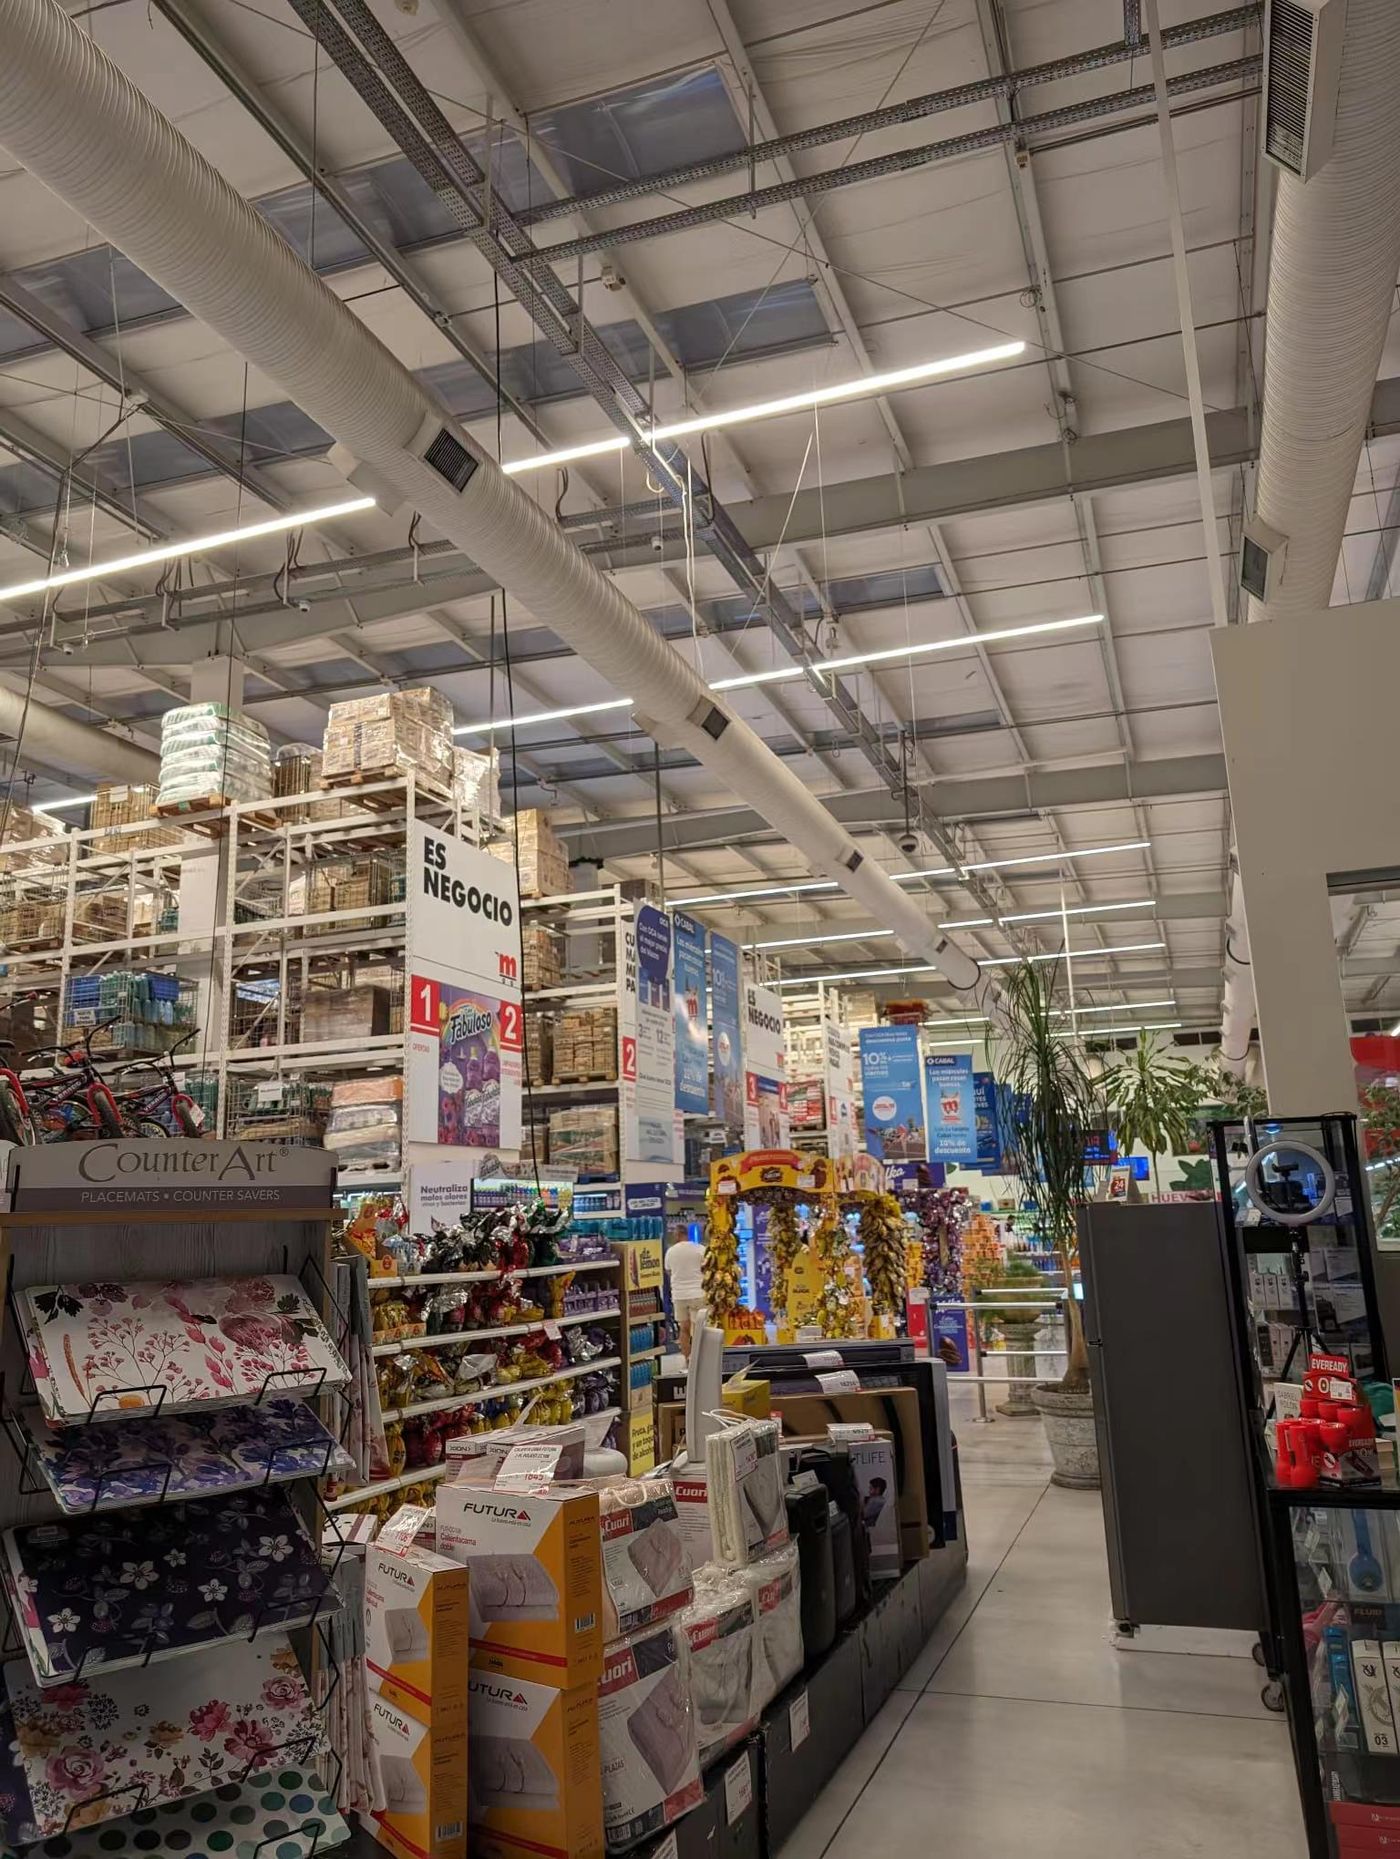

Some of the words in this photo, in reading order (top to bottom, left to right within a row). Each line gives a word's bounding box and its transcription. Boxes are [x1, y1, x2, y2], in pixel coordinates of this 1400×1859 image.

[424, 836, 446, 871] ES
[424, 867, 512, 926] NEGOCIO
[420, 983, 432, 1022] 1
[748, 988, 756, 1006] ES
[450, 1011, 492, 1045] Fabuloso
[504, 1005, 517, 1040] 2
[748, 1006, 780, 1034] NEGOCIO
[626, 1043, 635, 1072] 2
[863, 1052, 880, 1065] 10
[420, 1184, 468, 1195] Neutraliza
[1114, 1180, 1126, 1189] 24
[81, 1191, 160, 1203] PLACEMATS
[173, 1189, 233, 1202] COUNTER
[236, 1189, 280, 1201] SAVERS
[420, 1194, 443, 1202] malos
[1311, 1358, 1347, 1372] EVEREADY
[464, 1502, 531, 1521] FUTURA
[605, 1516, 630, 1532] Cuori
[440, 1534, 477, 1547] Calientacama
[378, 1563, 415, 1586] FUTURA
[374, 1703, 410, 1736] FUTURA
[1374, 1735, 1389, 1746] 03
[604, 1760, 625, 1774] PLAZAS
